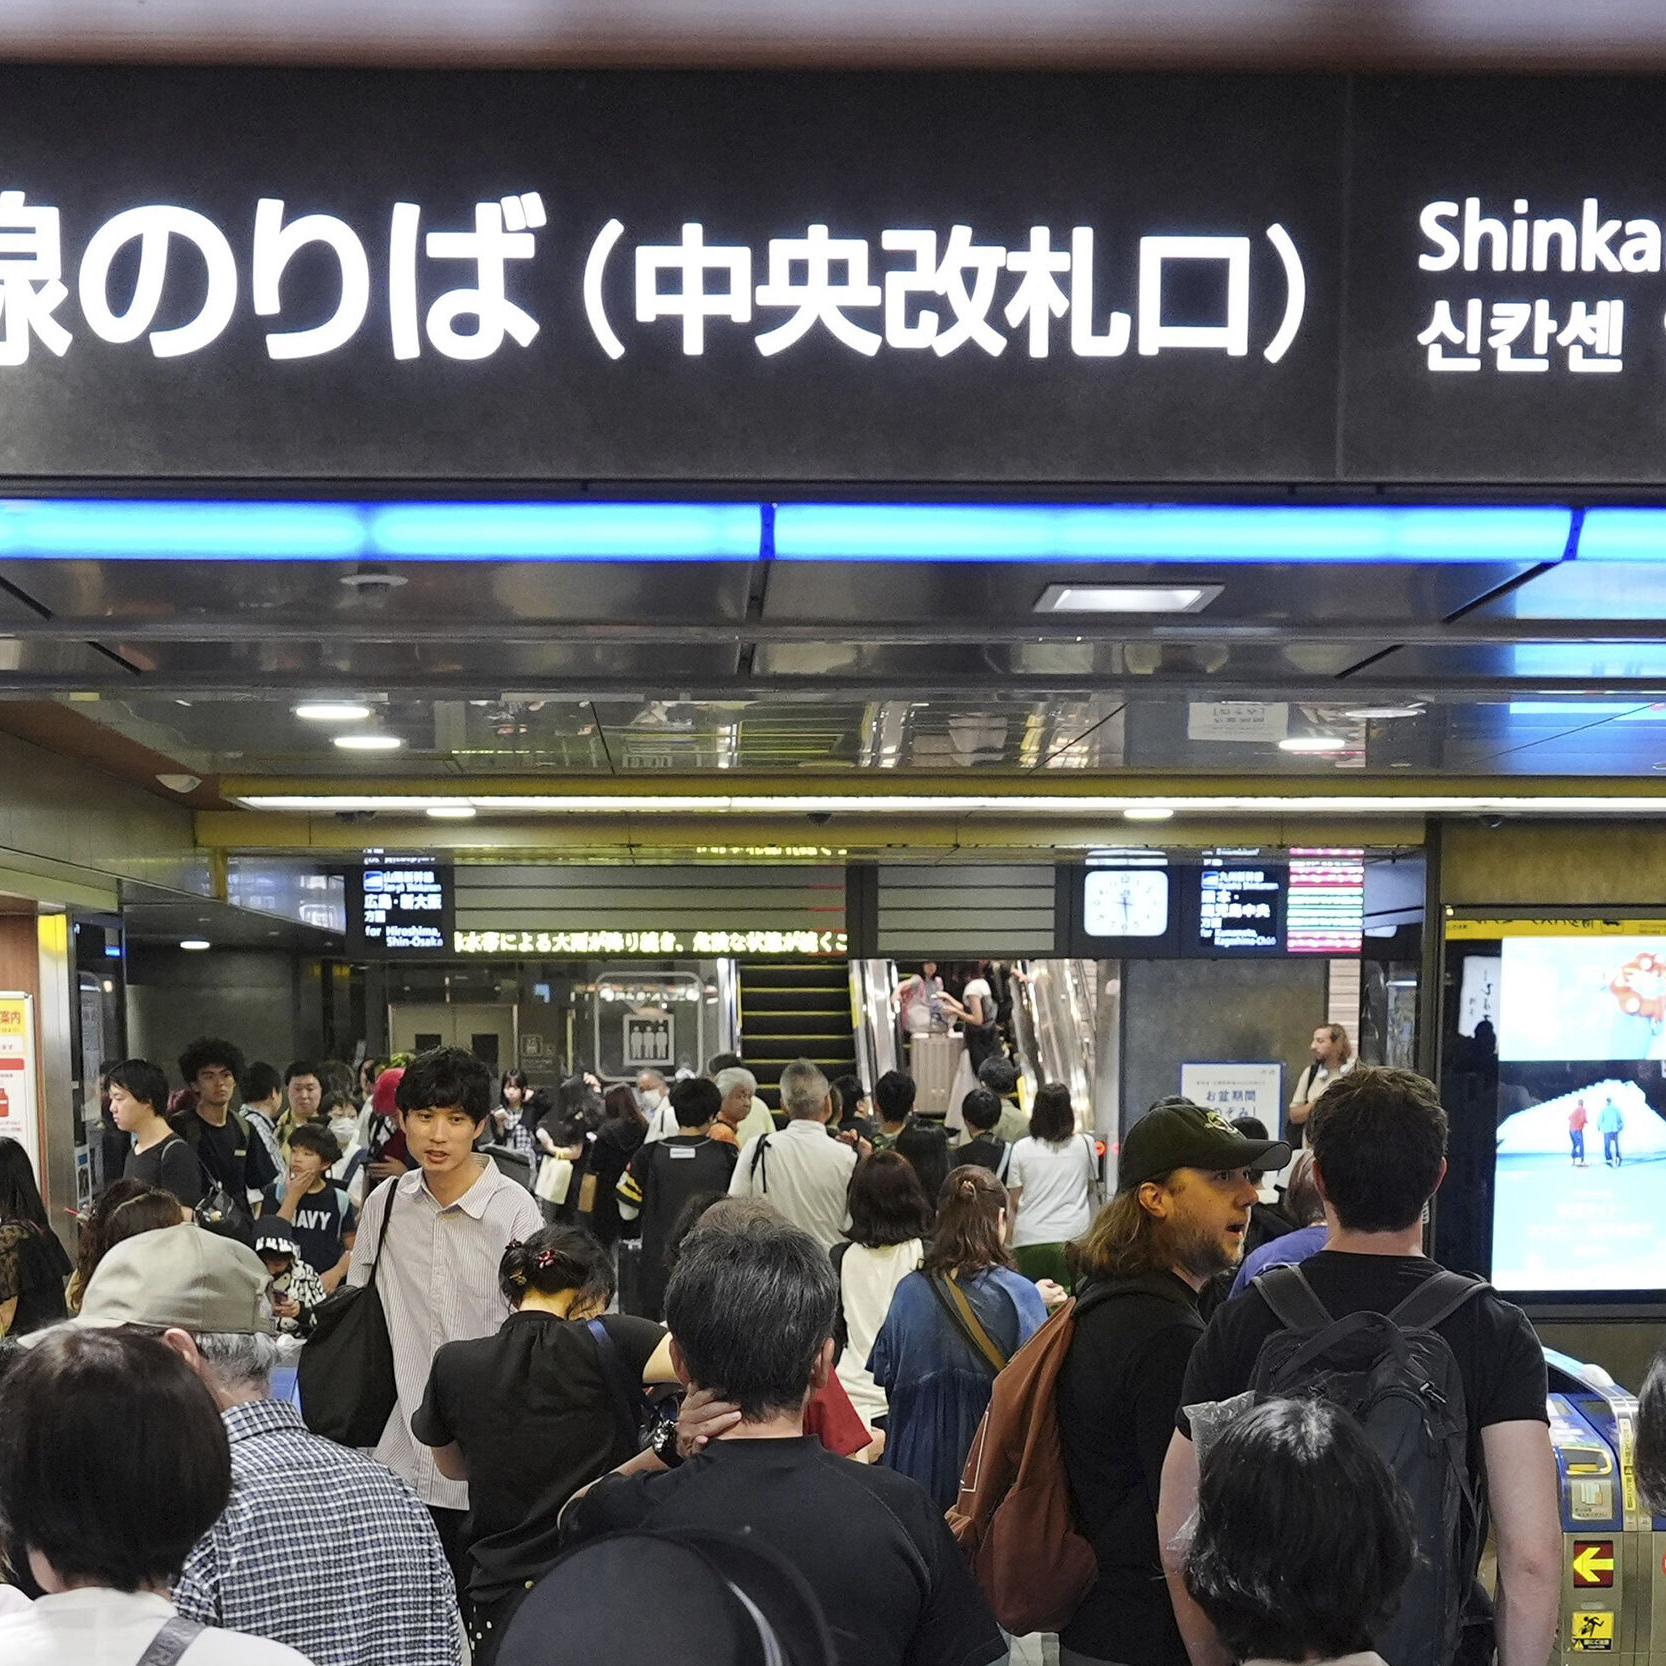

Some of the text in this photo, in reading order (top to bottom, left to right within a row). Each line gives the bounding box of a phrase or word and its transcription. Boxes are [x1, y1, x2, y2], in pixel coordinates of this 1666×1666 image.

[1416, 298, 1625, 374] 신칸센
[365, 925, 442, 937] for Hiroshima,
